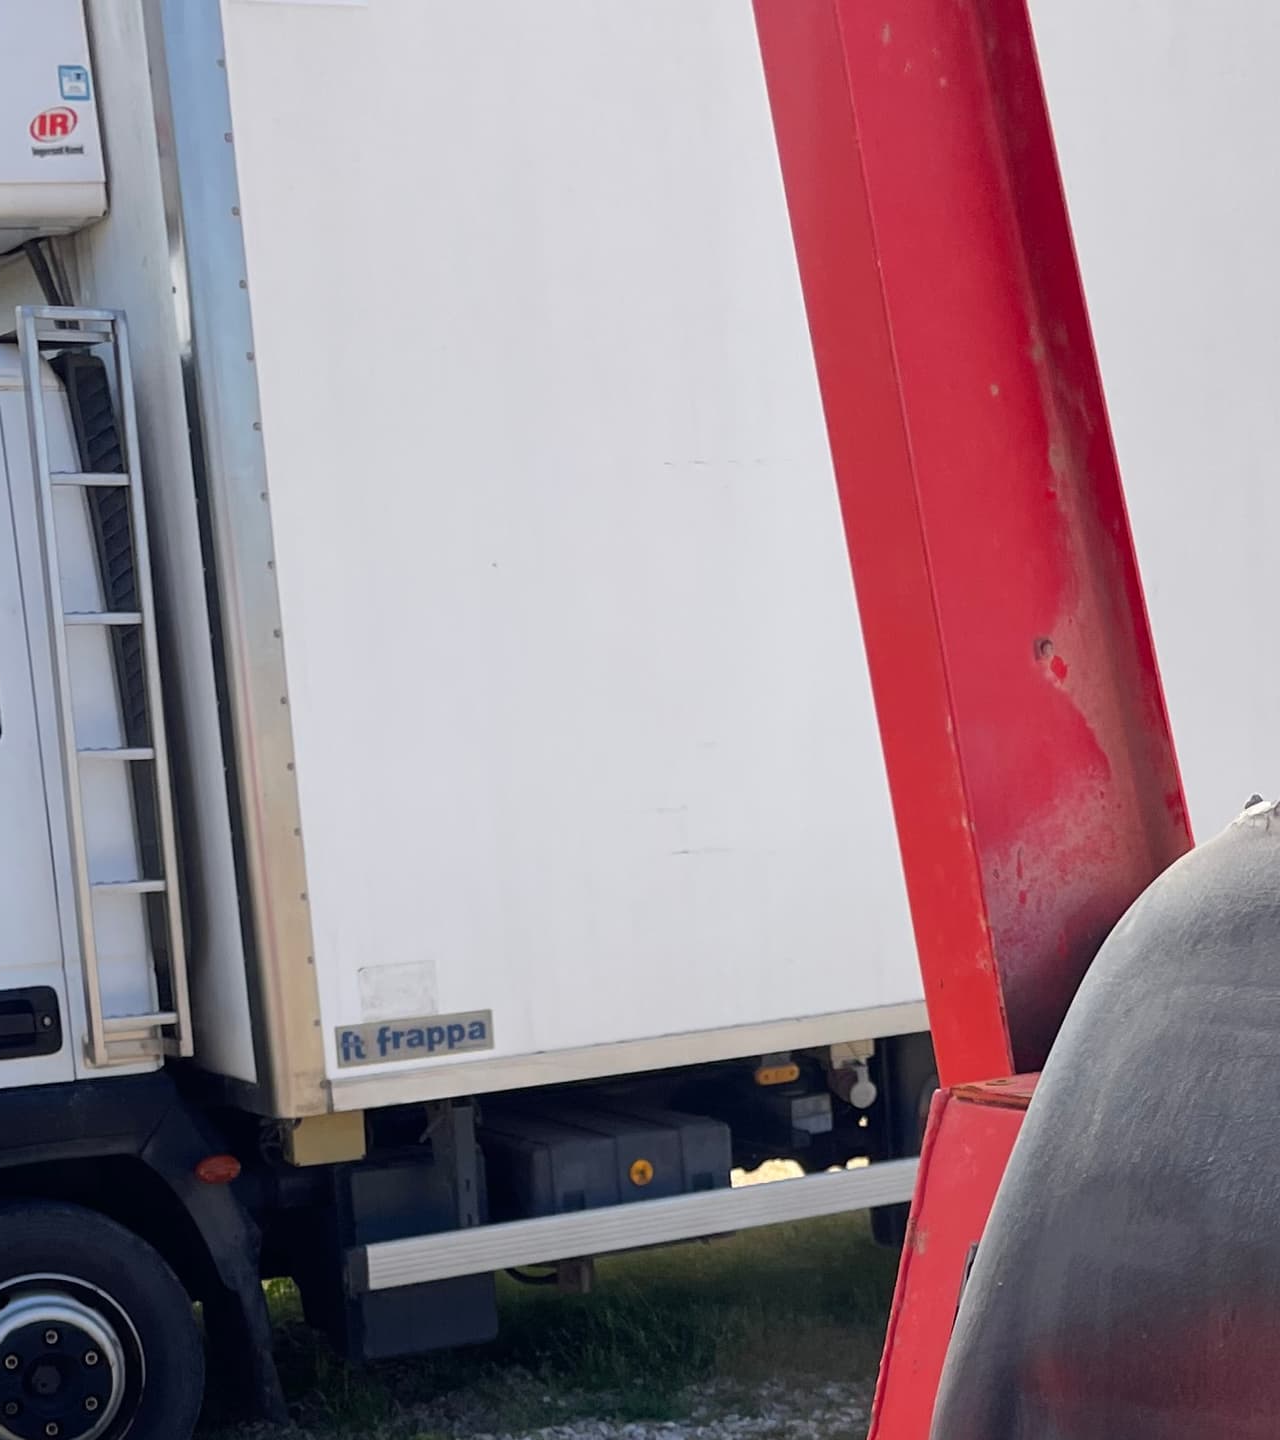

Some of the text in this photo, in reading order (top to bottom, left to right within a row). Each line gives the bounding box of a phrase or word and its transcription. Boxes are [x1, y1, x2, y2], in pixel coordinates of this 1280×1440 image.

[38, 112, 69, 137] IR
[341, 1020, 487, 1061] ft frappa
